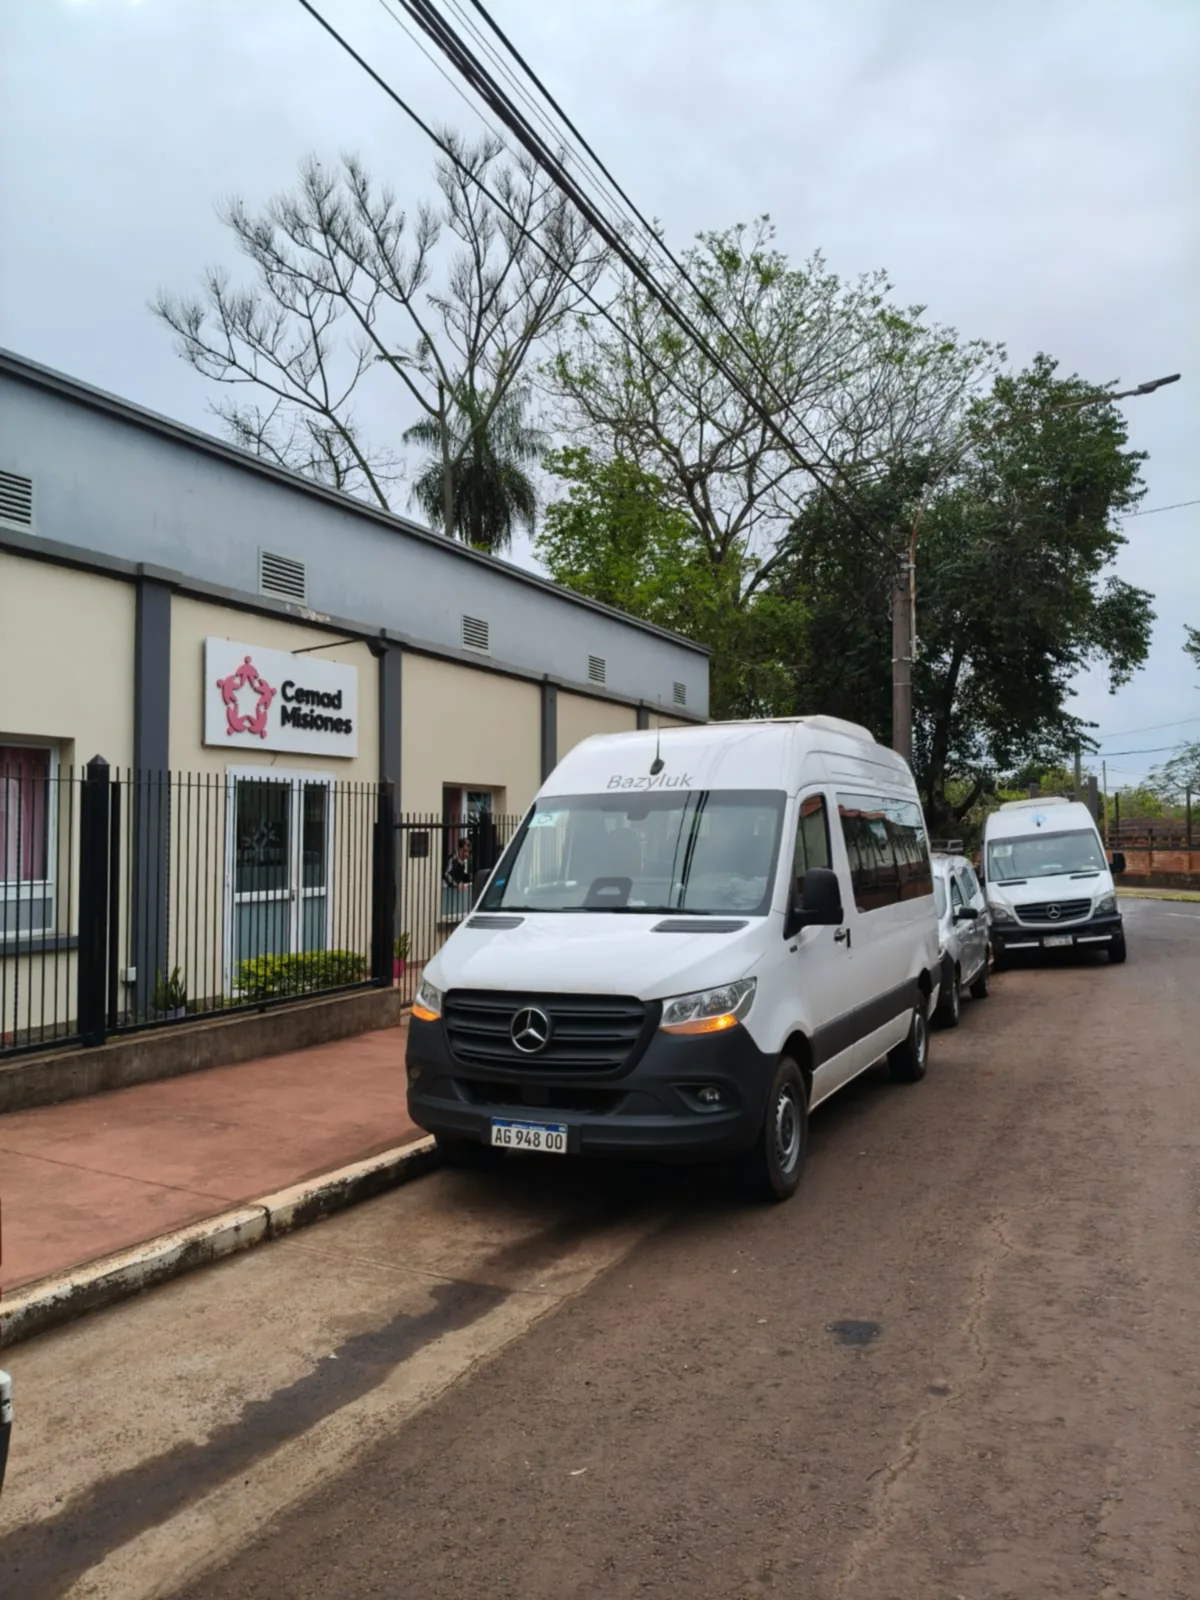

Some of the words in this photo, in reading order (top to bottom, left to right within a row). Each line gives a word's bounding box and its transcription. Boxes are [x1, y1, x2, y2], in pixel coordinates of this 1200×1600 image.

[281, 680, 342, 710] Cemad
[281, 705, 352, 735] Misiones
[607, 773, 694, 791] Bazyluk
[495, 1128, 512, 1144] AG
[515, 1130, 541, 1148] 948
